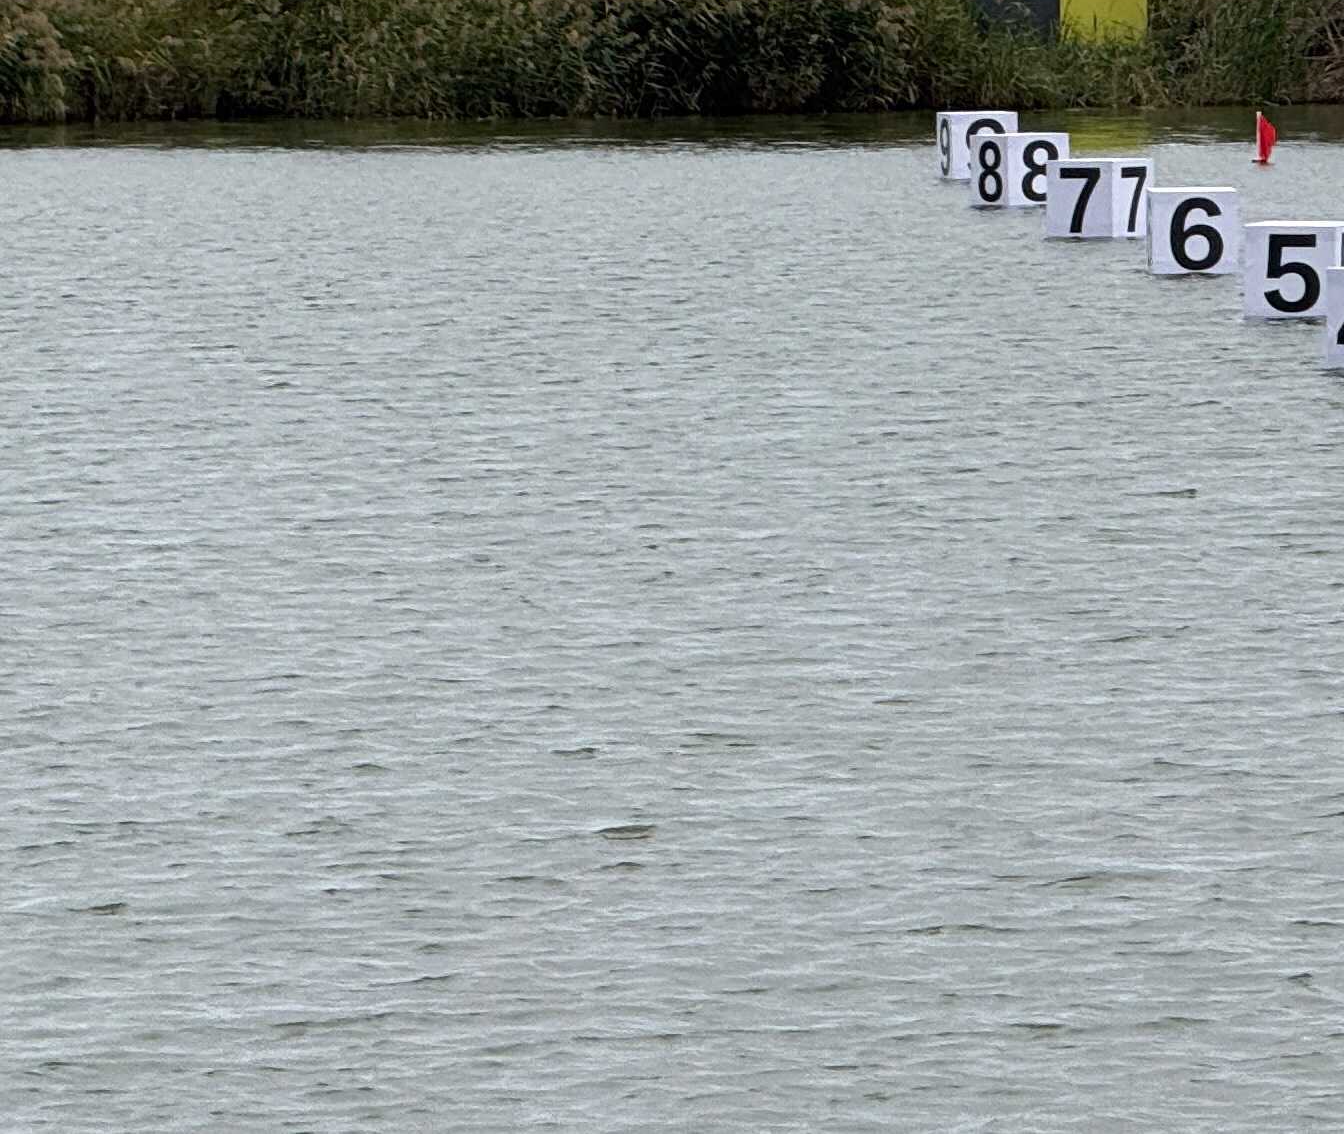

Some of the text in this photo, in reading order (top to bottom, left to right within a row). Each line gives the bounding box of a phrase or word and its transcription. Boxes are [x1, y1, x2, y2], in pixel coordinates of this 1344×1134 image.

[939, 118, 950, 176] 9
[978, 140, 1003, 203] 8
[1021, 140, 1059, 202] 8
[1059, 167, 1101, 234] 7
[1120, 165, 1148, 233] 7
[1169, 197, 1224, 271] 6
[1264, 233, 1321, 313] 5
